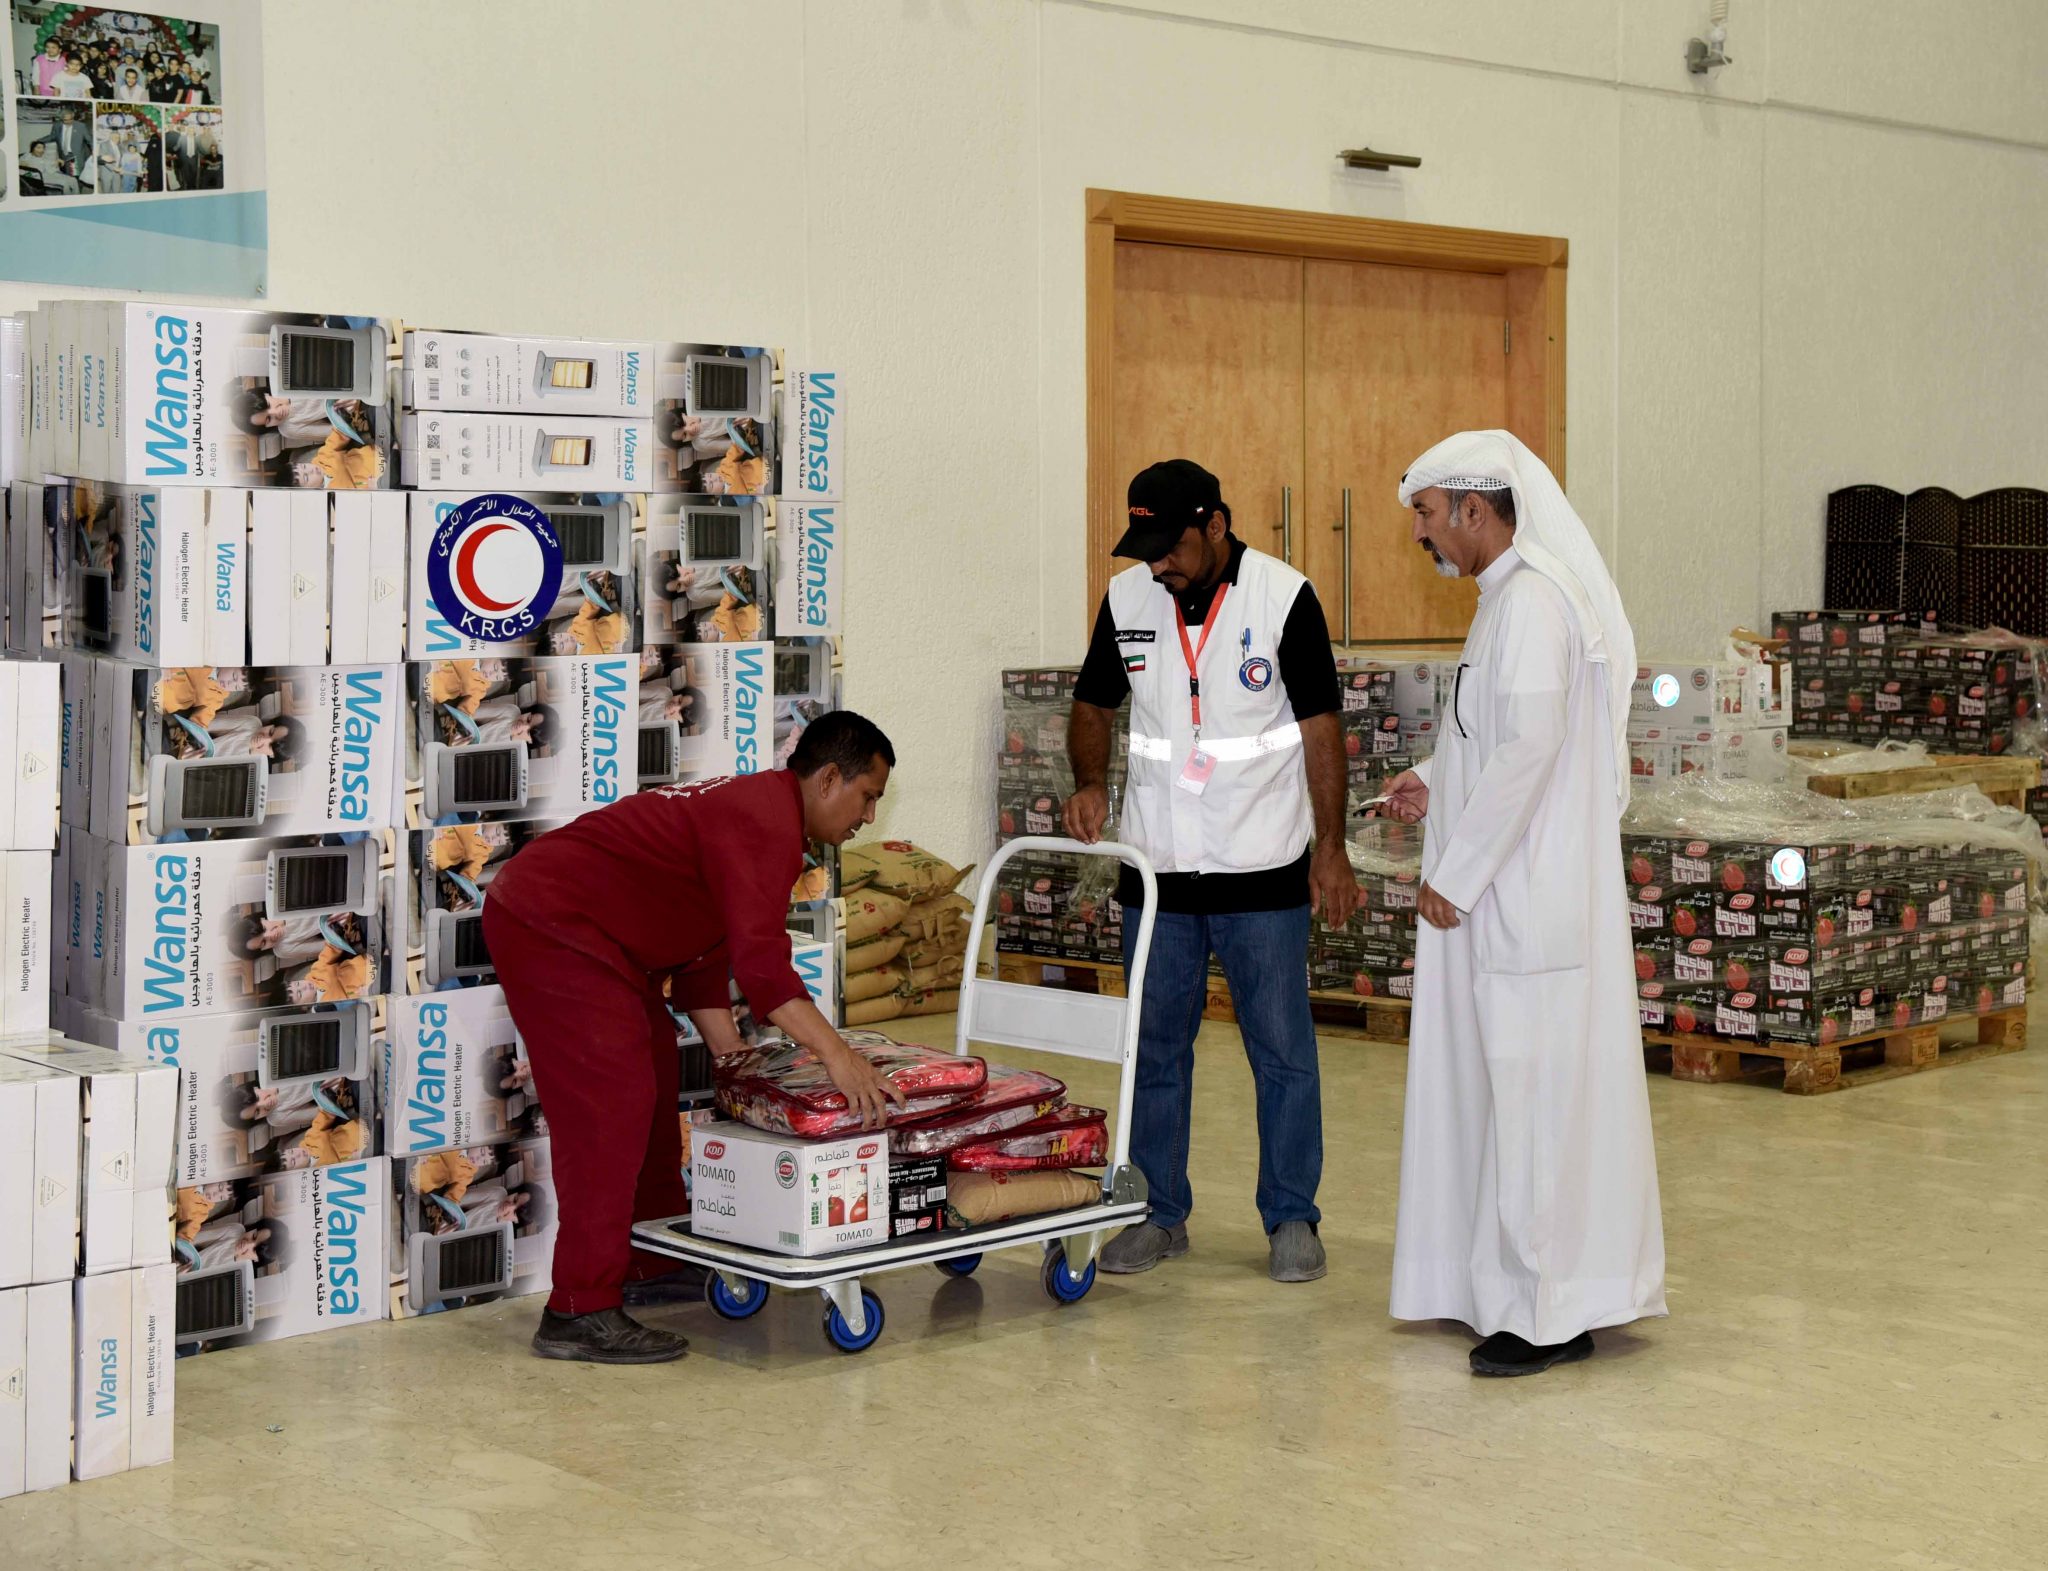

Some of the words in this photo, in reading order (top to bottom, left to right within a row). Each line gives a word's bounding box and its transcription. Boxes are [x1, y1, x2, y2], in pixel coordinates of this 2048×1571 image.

[84, 354, 92, 423] Wansa
[146, 315, 188, 476] Wansa
[626, 351, 640, 406] Wansa
[808, 373, 835, 492] Wansa
[624, 428, 637, 482] Wansa
[180, 532, 189, 563] Halogen
[140, 494, 156, 653] Wansa
[181, 566, 190, 595] Electric
[217, 543, 236, 612] Wansa
[806, 508, 834, 626] Wansa
[181, 597, 190, 622] Heater
[460, 608, 534, 638] K.R.C.S
[722, 648, 730, 680] Halogen
[736, 648, 763, 776] Wansa
[340, 671, 382, 821] Wansa
[592, 661, 626, 804] Wansa
[21, 897, 30, 924] Heater
[1732, 897, 1752, 905] KDD
[94, 890, 103, 958] Wansa
[144, 855, 188, 1013] Wansa
[21, 926, 30, 957] Electric
[1786, 952, 1805, 960] KDD
[20, 959, 30, 992] Halogen
[206, 972, 214, 1006] AE-3003
[1388, 975, 1414, 986] POWE
[1389, 986, 1413, 998] FRUIT
[1734, 996, 1752, 1004] KDD
[453, 1043, 464, 1072] Heater
[188, 1070, 198, 1102] Heater
[408, 1002, 448, 1152] Wansa
[453, 1074, 464, 1106] Electric
[188, 1104, 198, 1140] Electric
[453, 1110, 464, 1146] Halogen
[187, 1142, 198, 1180] Halogen
[200, 1144, 208, 1178] AE-3003
[706, 1144, 724, 1156] KDD
[814, 1148, 850, 1165] طماطم
[858, 1146, 878, 1156] KDD
[300, 1170, 308, 1204] AE-3003
[697, 1163, 736, 1183] TOMATO
[697, 1198, 736, 1216] طماطم
[326, 1163, 367, 1315] Wansa
[836, 1228, 873, 1243] TOMATO
[147, 1315, 156, 1344] Heater
[96, 1338, 118, 1418] Wansa
[147, 1345, 156, 1379] Electric
[146, 1381, 156, 1416] Halogen
